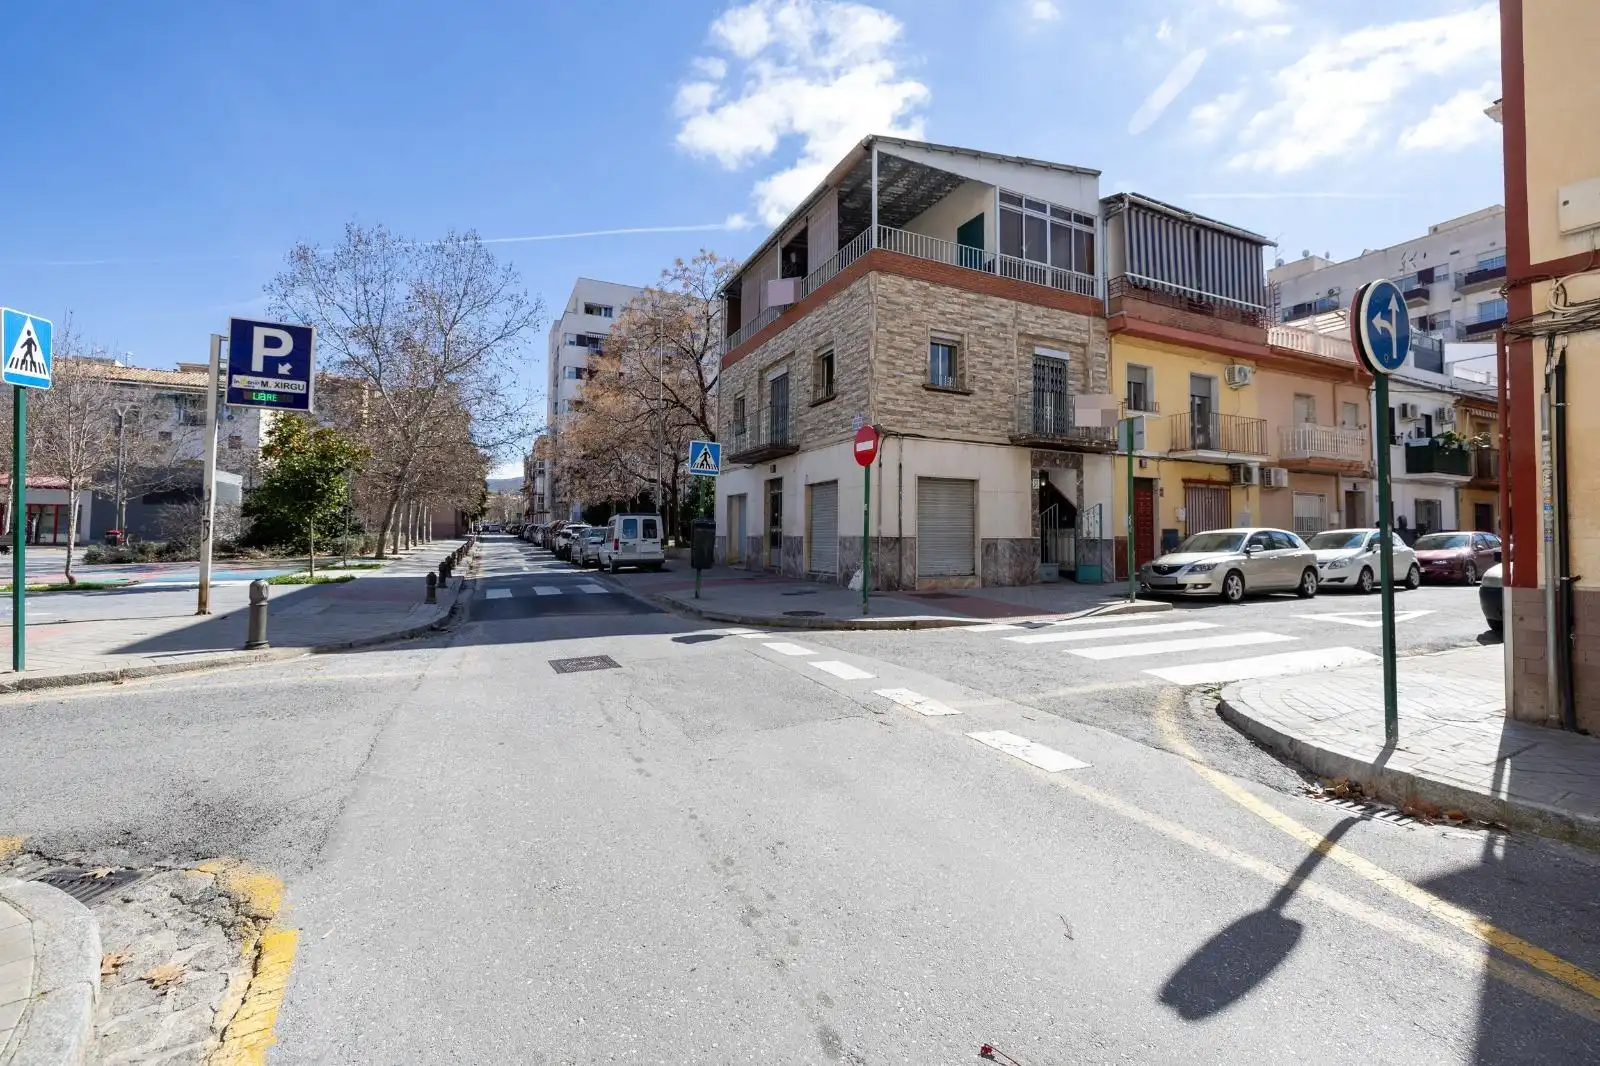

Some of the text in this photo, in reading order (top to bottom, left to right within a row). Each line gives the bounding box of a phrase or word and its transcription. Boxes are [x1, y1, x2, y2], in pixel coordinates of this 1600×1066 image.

[251, 326, 294, 373] P
[260, 380, 272, 389] M.
[274, 381, 305, 391] XIRGU
